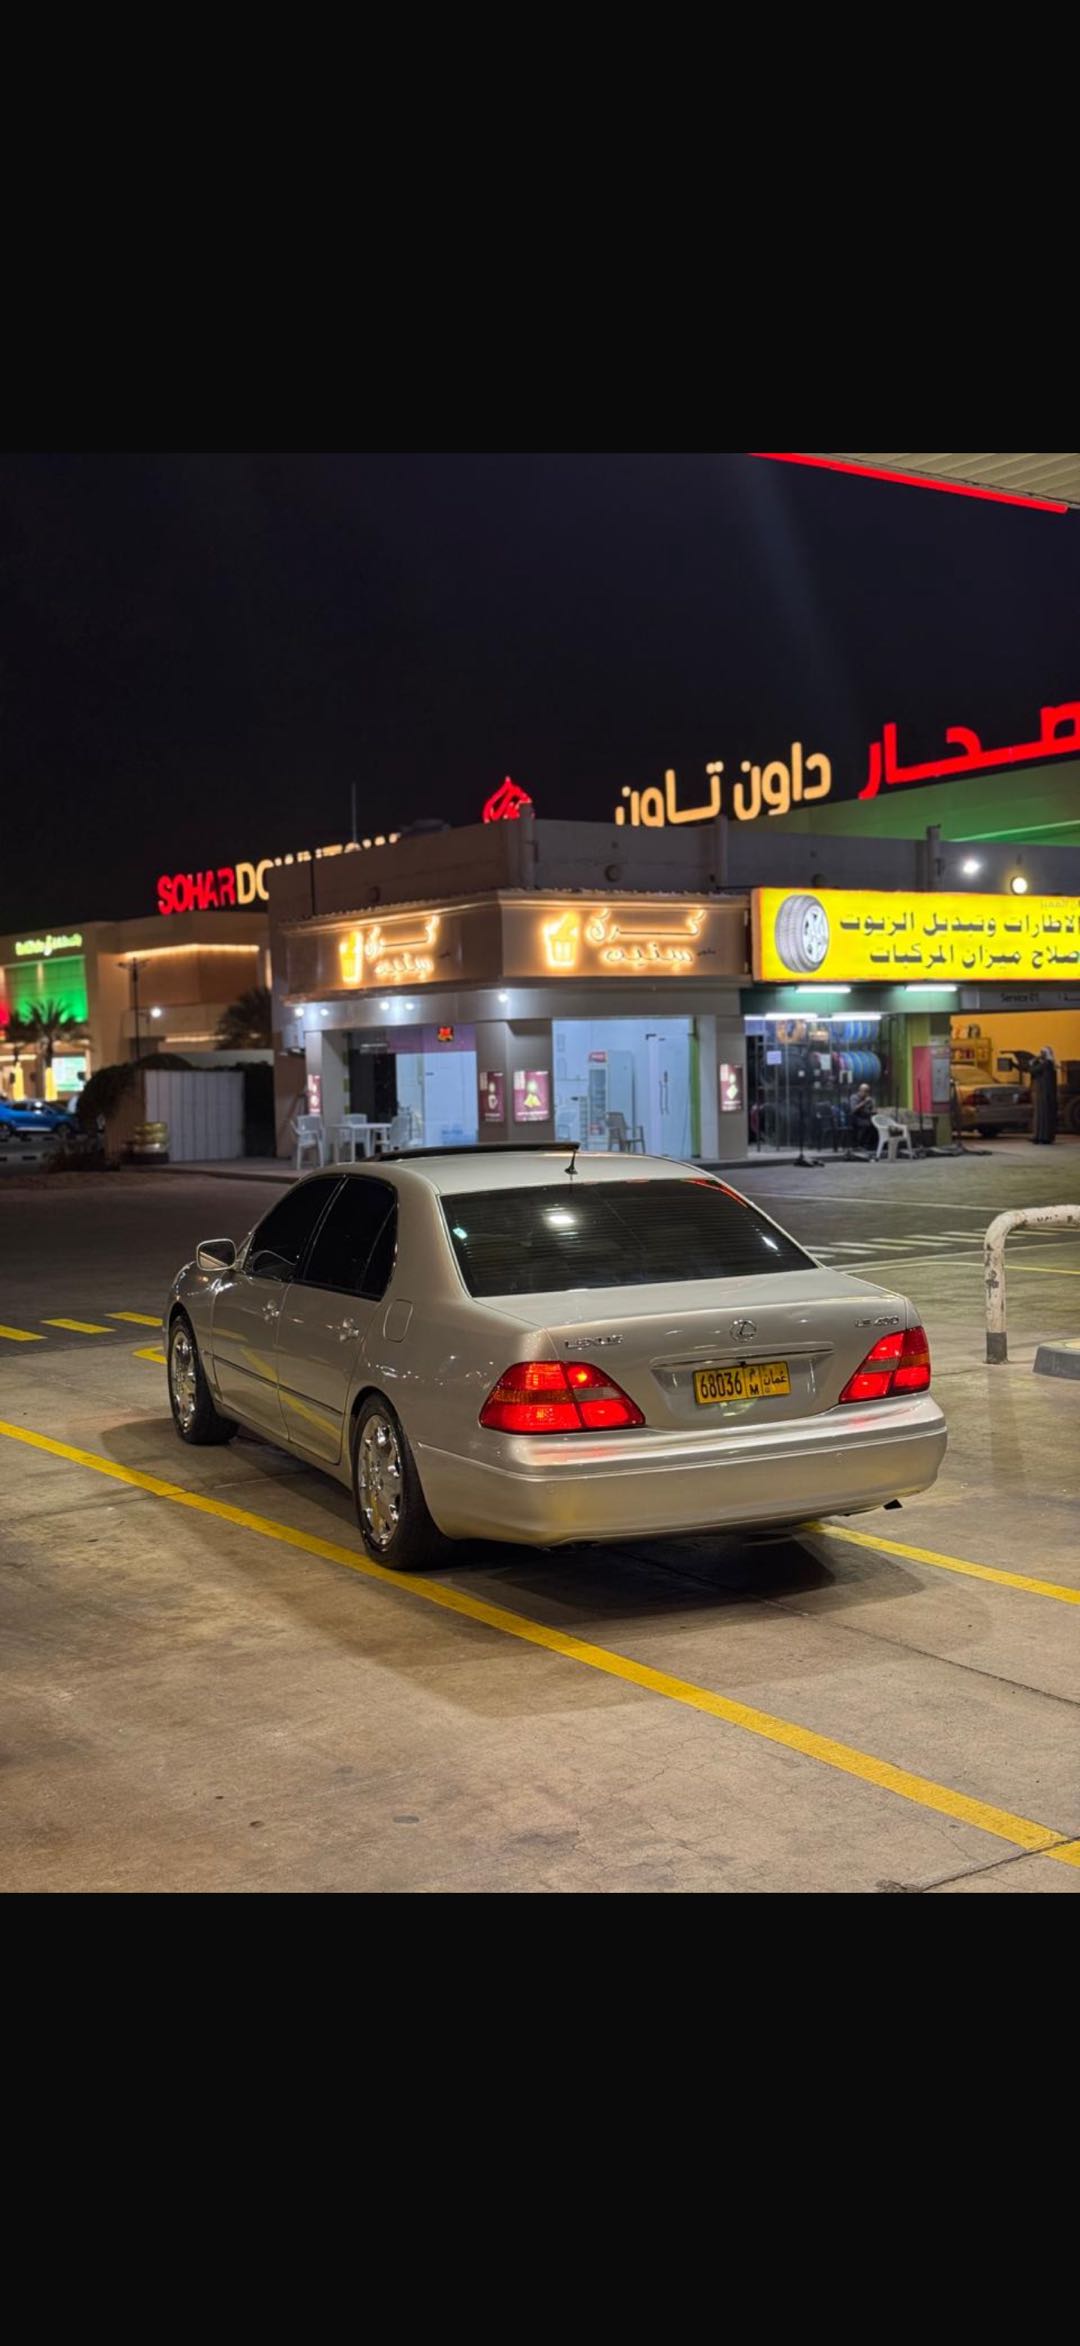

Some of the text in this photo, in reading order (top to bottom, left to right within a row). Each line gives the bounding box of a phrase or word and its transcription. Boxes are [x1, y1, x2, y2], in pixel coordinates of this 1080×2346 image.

[734, 742, 831, 820] داون
[157, 866, 236, 915] SOHAR
[1030, 945, 1080, 969] صلاح
[700, 1371, 742, 1398] 68036
